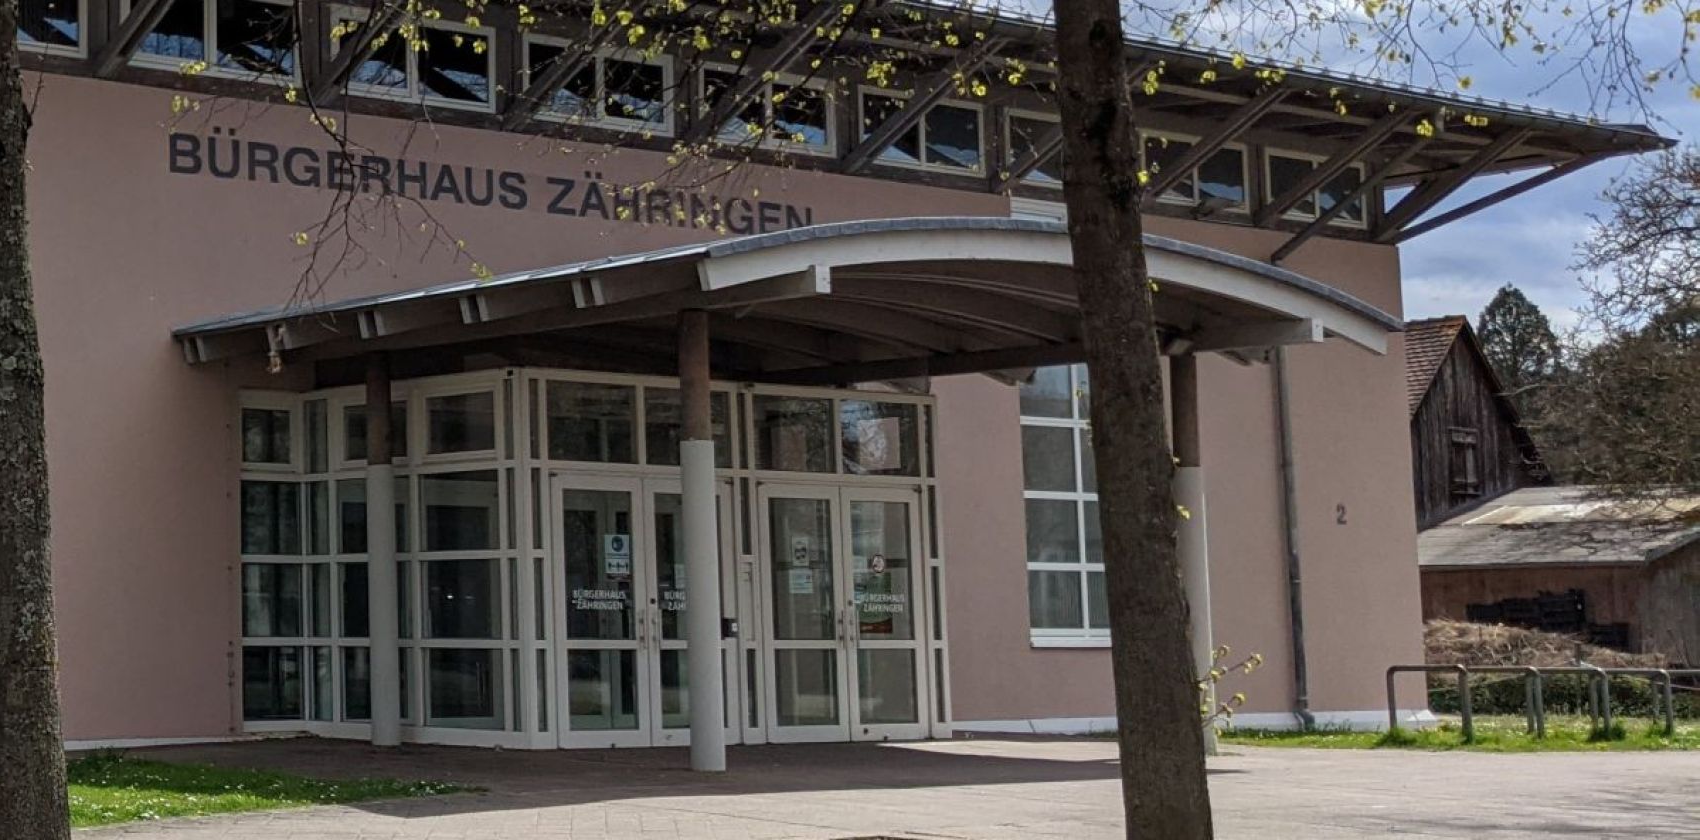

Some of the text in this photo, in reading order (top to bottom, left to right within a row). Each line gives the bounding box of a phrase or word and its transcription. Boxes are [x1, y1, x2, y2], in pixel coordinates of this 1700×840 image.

[168, 126, 813, 235] BÜRGERHAUS ZÄHRINGEN
[1336, 503, 1347, 525] 2
